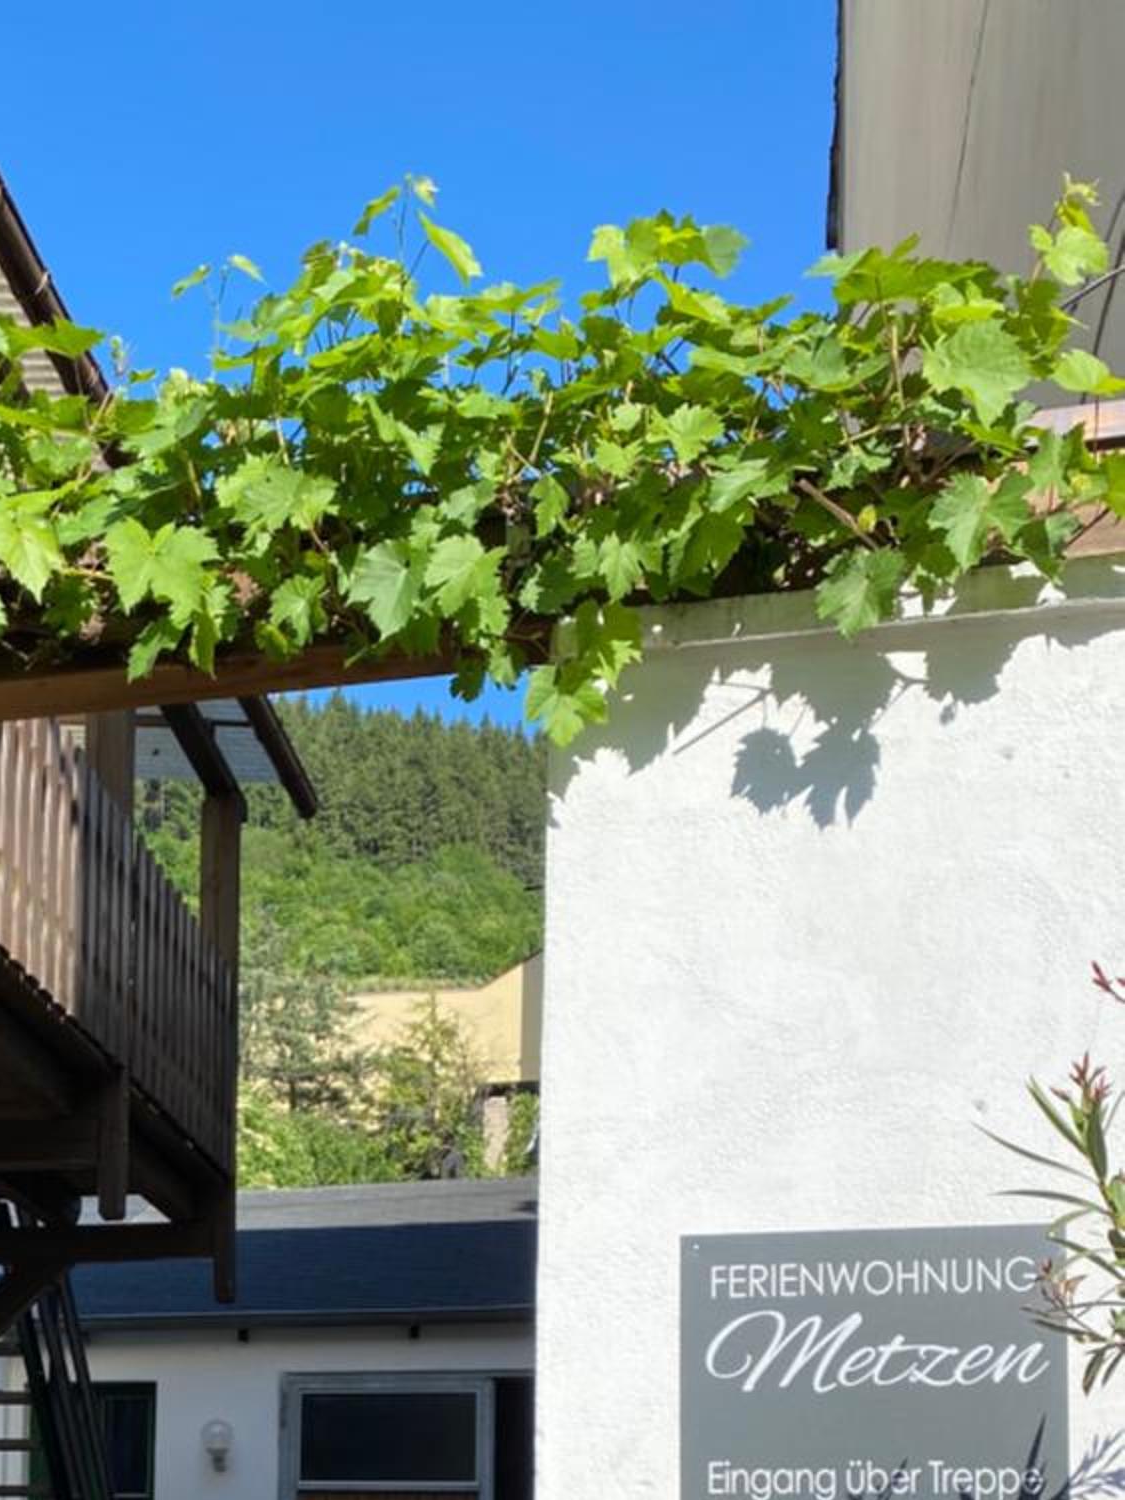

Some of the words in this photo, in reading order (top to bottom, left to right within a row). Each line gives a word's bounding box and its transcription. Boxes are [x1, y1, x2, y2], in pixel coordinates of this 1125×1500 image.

[710, 1256, 1037, 1298] FERIENWOHNUNG
[705, 1310, 1050, 1393] Metzen
[846, 1461, 920, 1496] über
